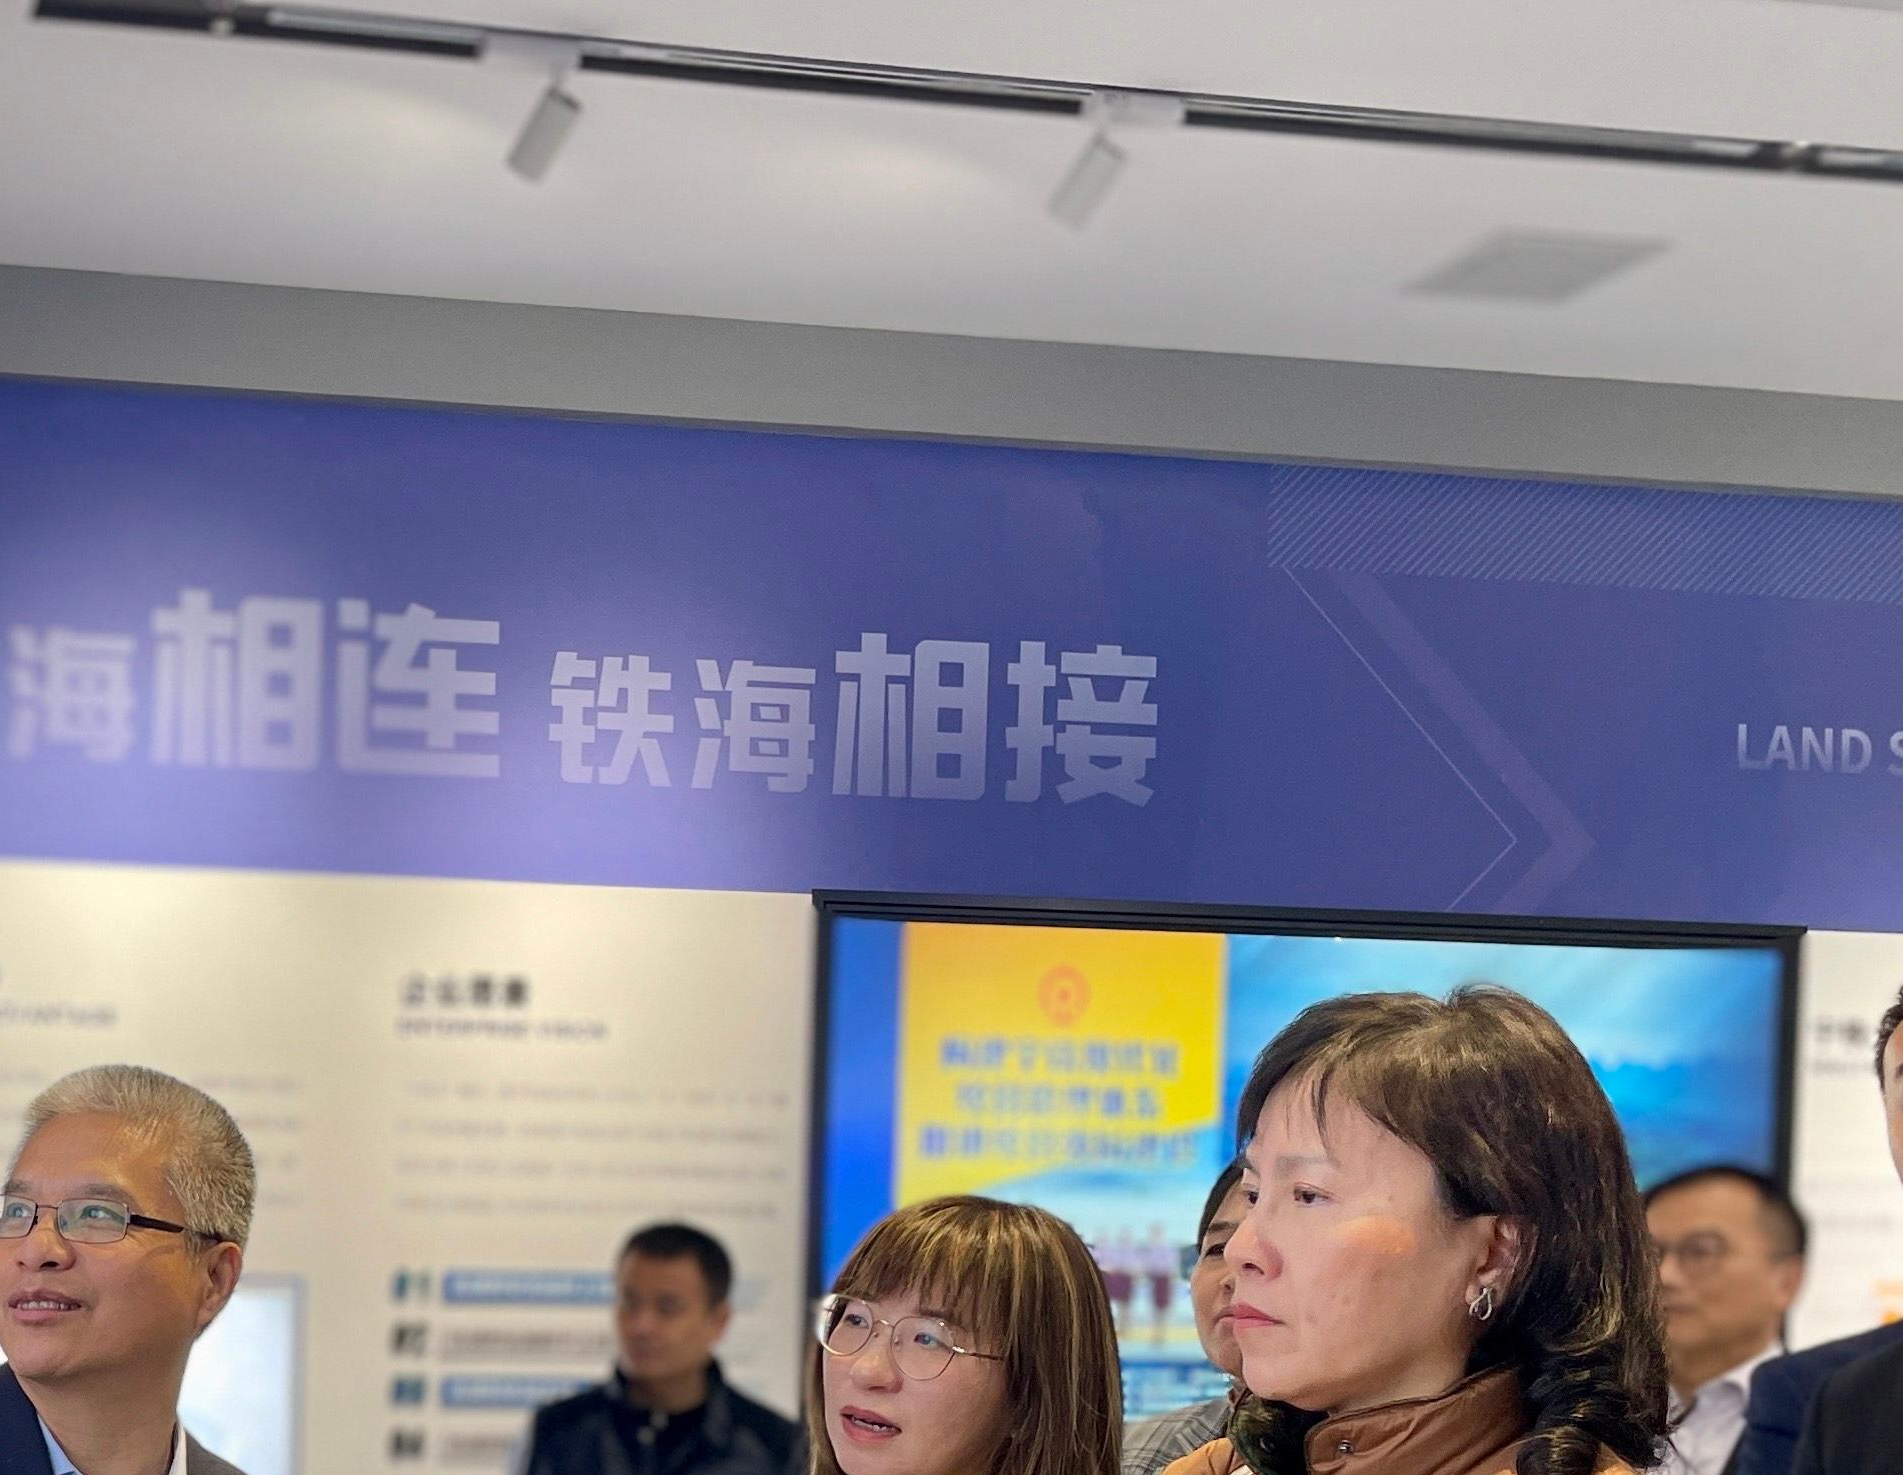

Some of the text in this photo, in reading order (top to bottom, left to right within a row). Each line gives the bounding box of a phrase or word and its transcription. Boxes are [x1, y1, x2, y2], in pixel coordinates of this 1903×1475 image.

[548, 632, 1159, 807] 铁海相接
[1736, 723, 1874, 776] LAND
